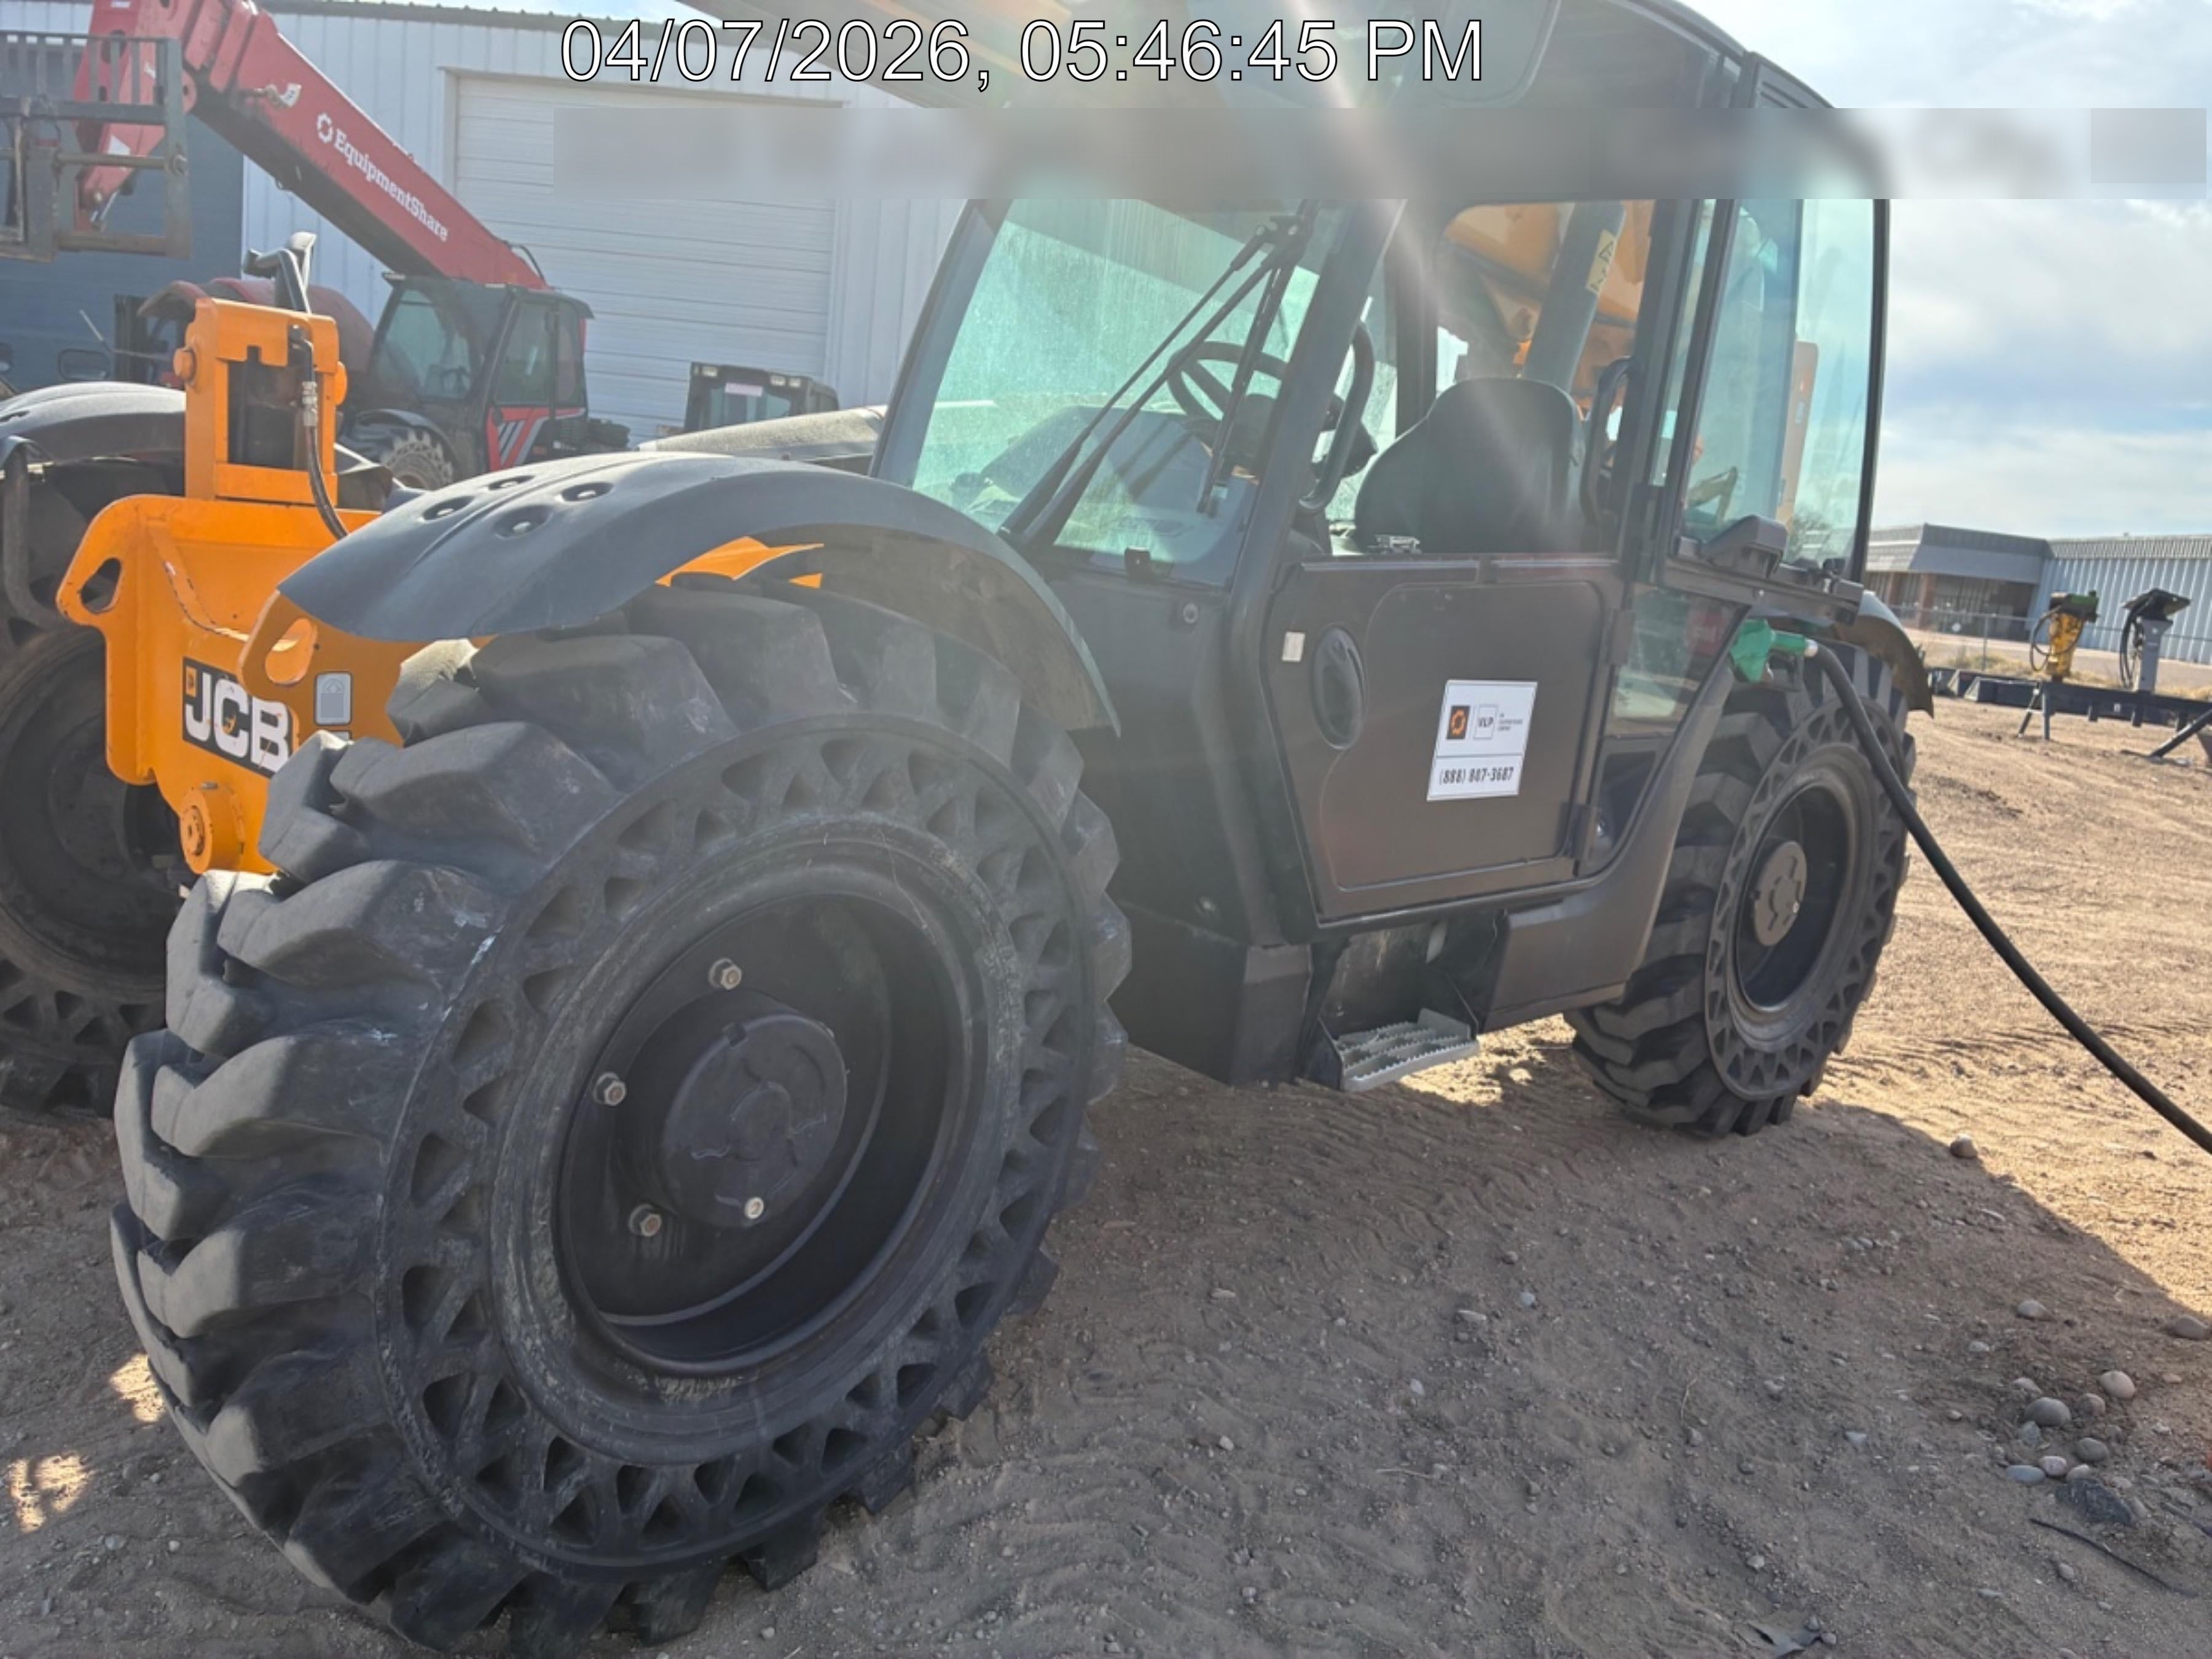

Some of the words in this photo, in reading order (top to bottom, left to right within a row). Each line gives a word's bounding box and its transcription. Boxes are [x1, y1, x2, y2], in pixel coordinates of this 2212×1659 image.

[334, 128, 449, 242] EquipmentShare
[185, 672, 288, 772] JCB
[1478, 716, 1494, 728] VLP
